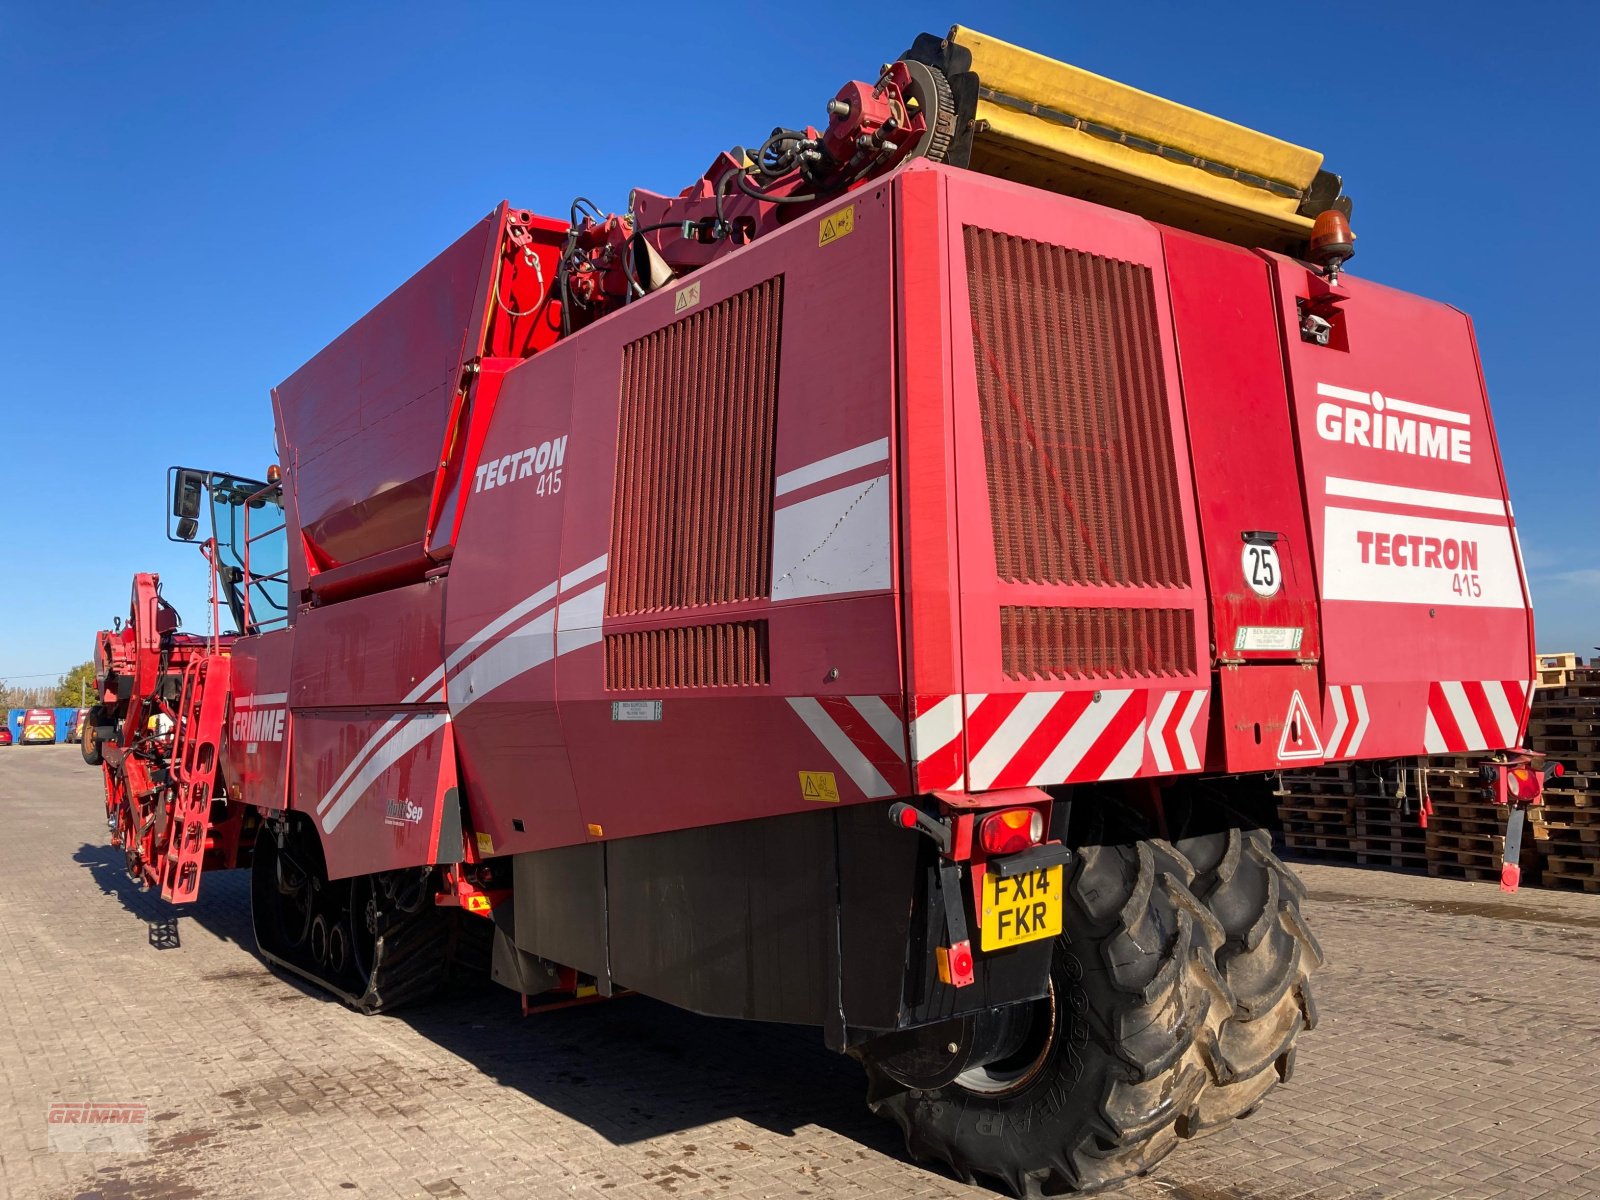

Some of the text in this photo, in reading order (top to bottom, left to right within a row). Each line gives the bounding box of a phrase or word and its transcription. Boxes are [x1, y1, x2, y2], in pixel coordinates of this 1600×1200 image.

[475, 434, 568, 493] TECTRON
[536, 468, 562, 498] 415
[1249, 547, 1275, 587] 25
[1357, 530, 1478, 571] TECTRON
[1452, 573, 1482, 598] 415
[233, 697, 286, 742] GRIMME
[995, 867, 1050, 906] FX14
[998, 901, 1047, 940] FKR
